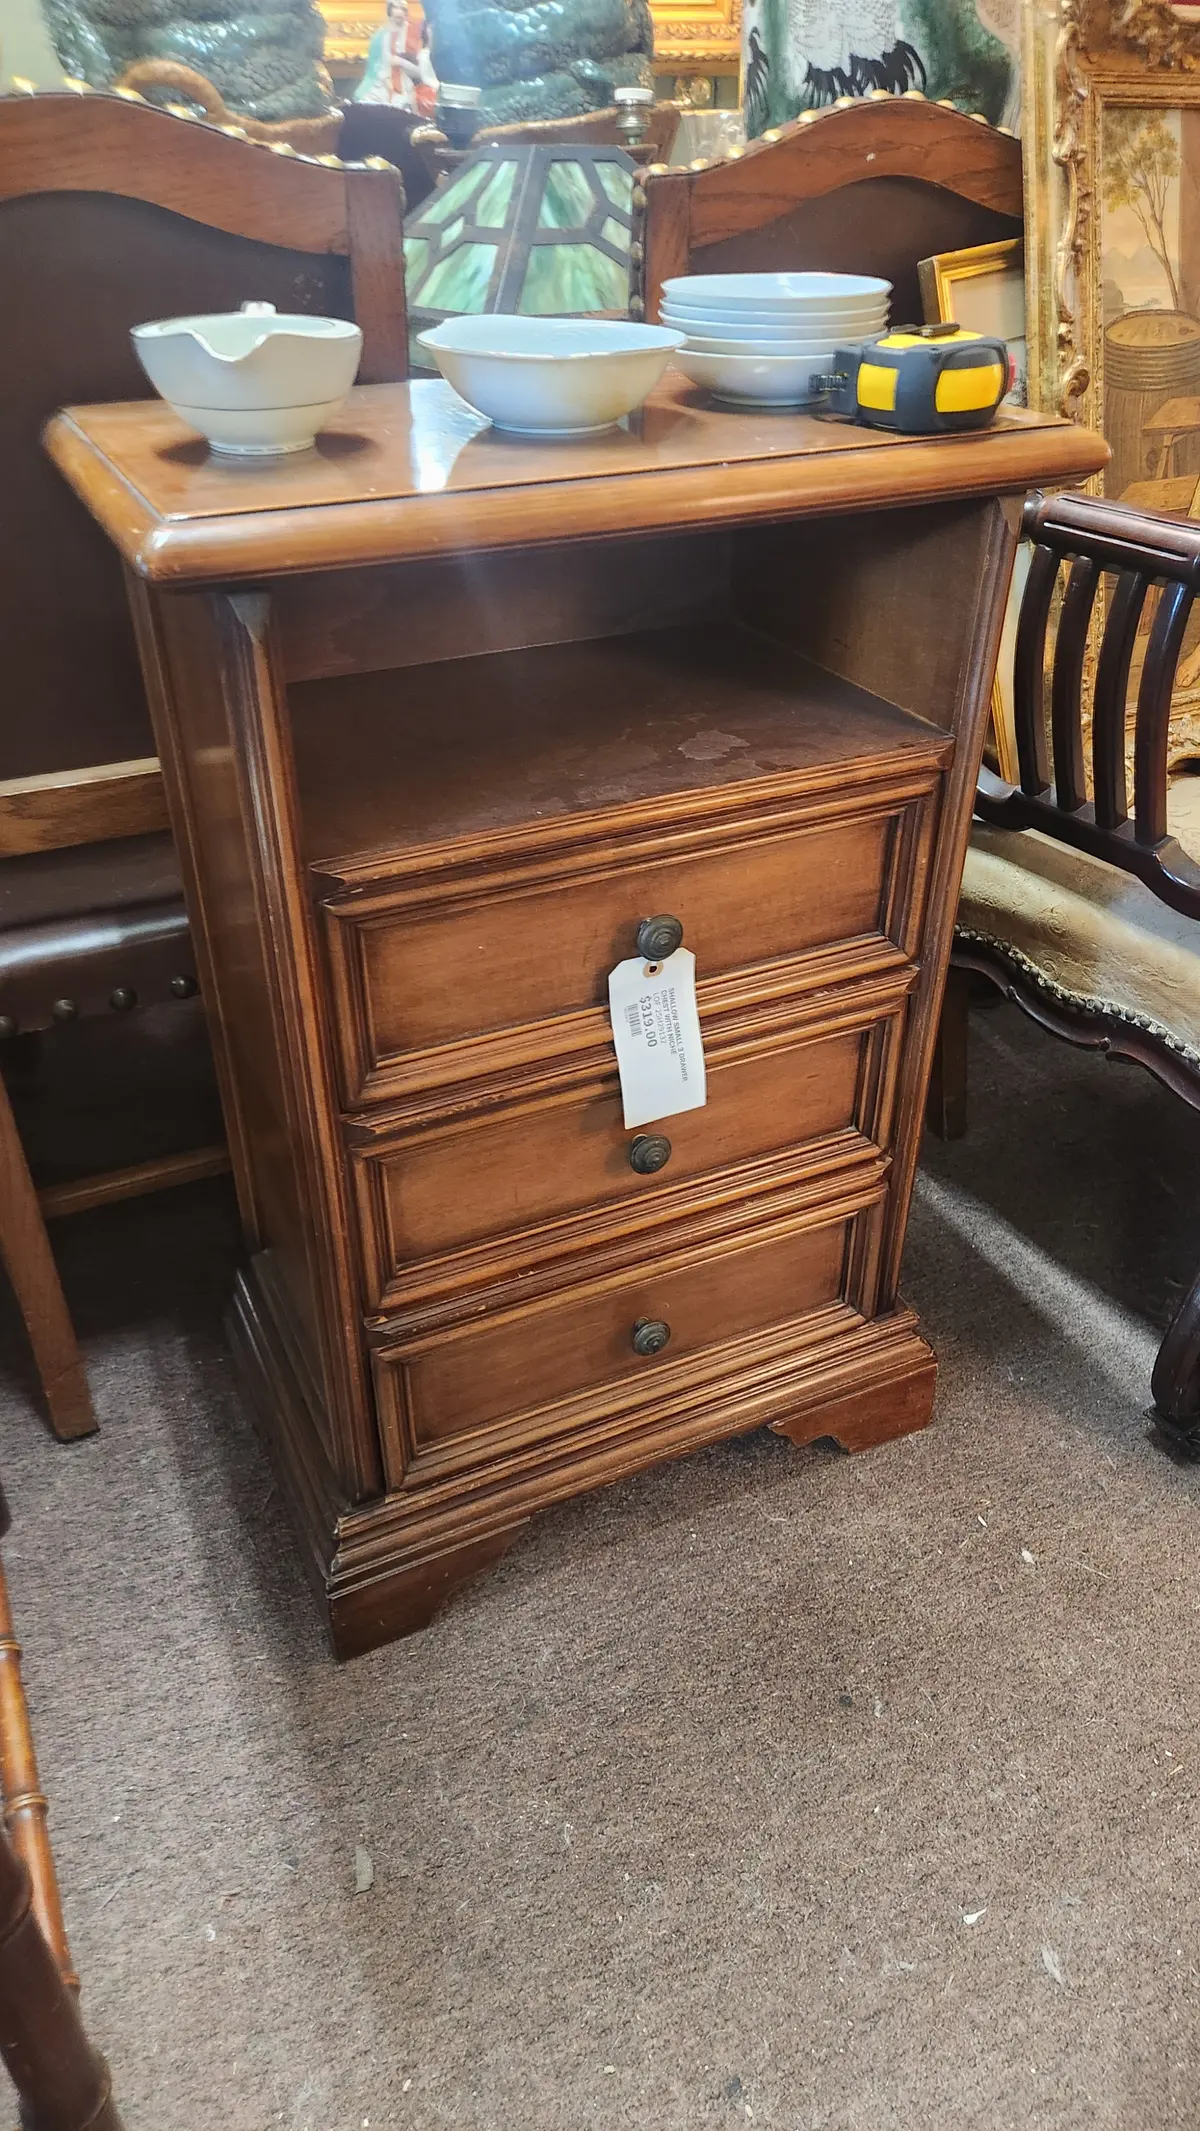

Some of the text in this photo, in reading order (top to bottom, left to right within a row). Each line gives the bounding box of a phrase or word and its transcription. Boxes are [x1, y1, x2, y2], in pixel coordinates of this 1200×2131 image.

[668, 988, 679, 1020] SHALLOW
[639, 995, 658, 1048] $319.00
[661, 989, 677, 1056] CHEST WITH NICHE
[673, 1022, 683, 1046] SMALL
[679, 1053, 688, 1082] DRAWER
